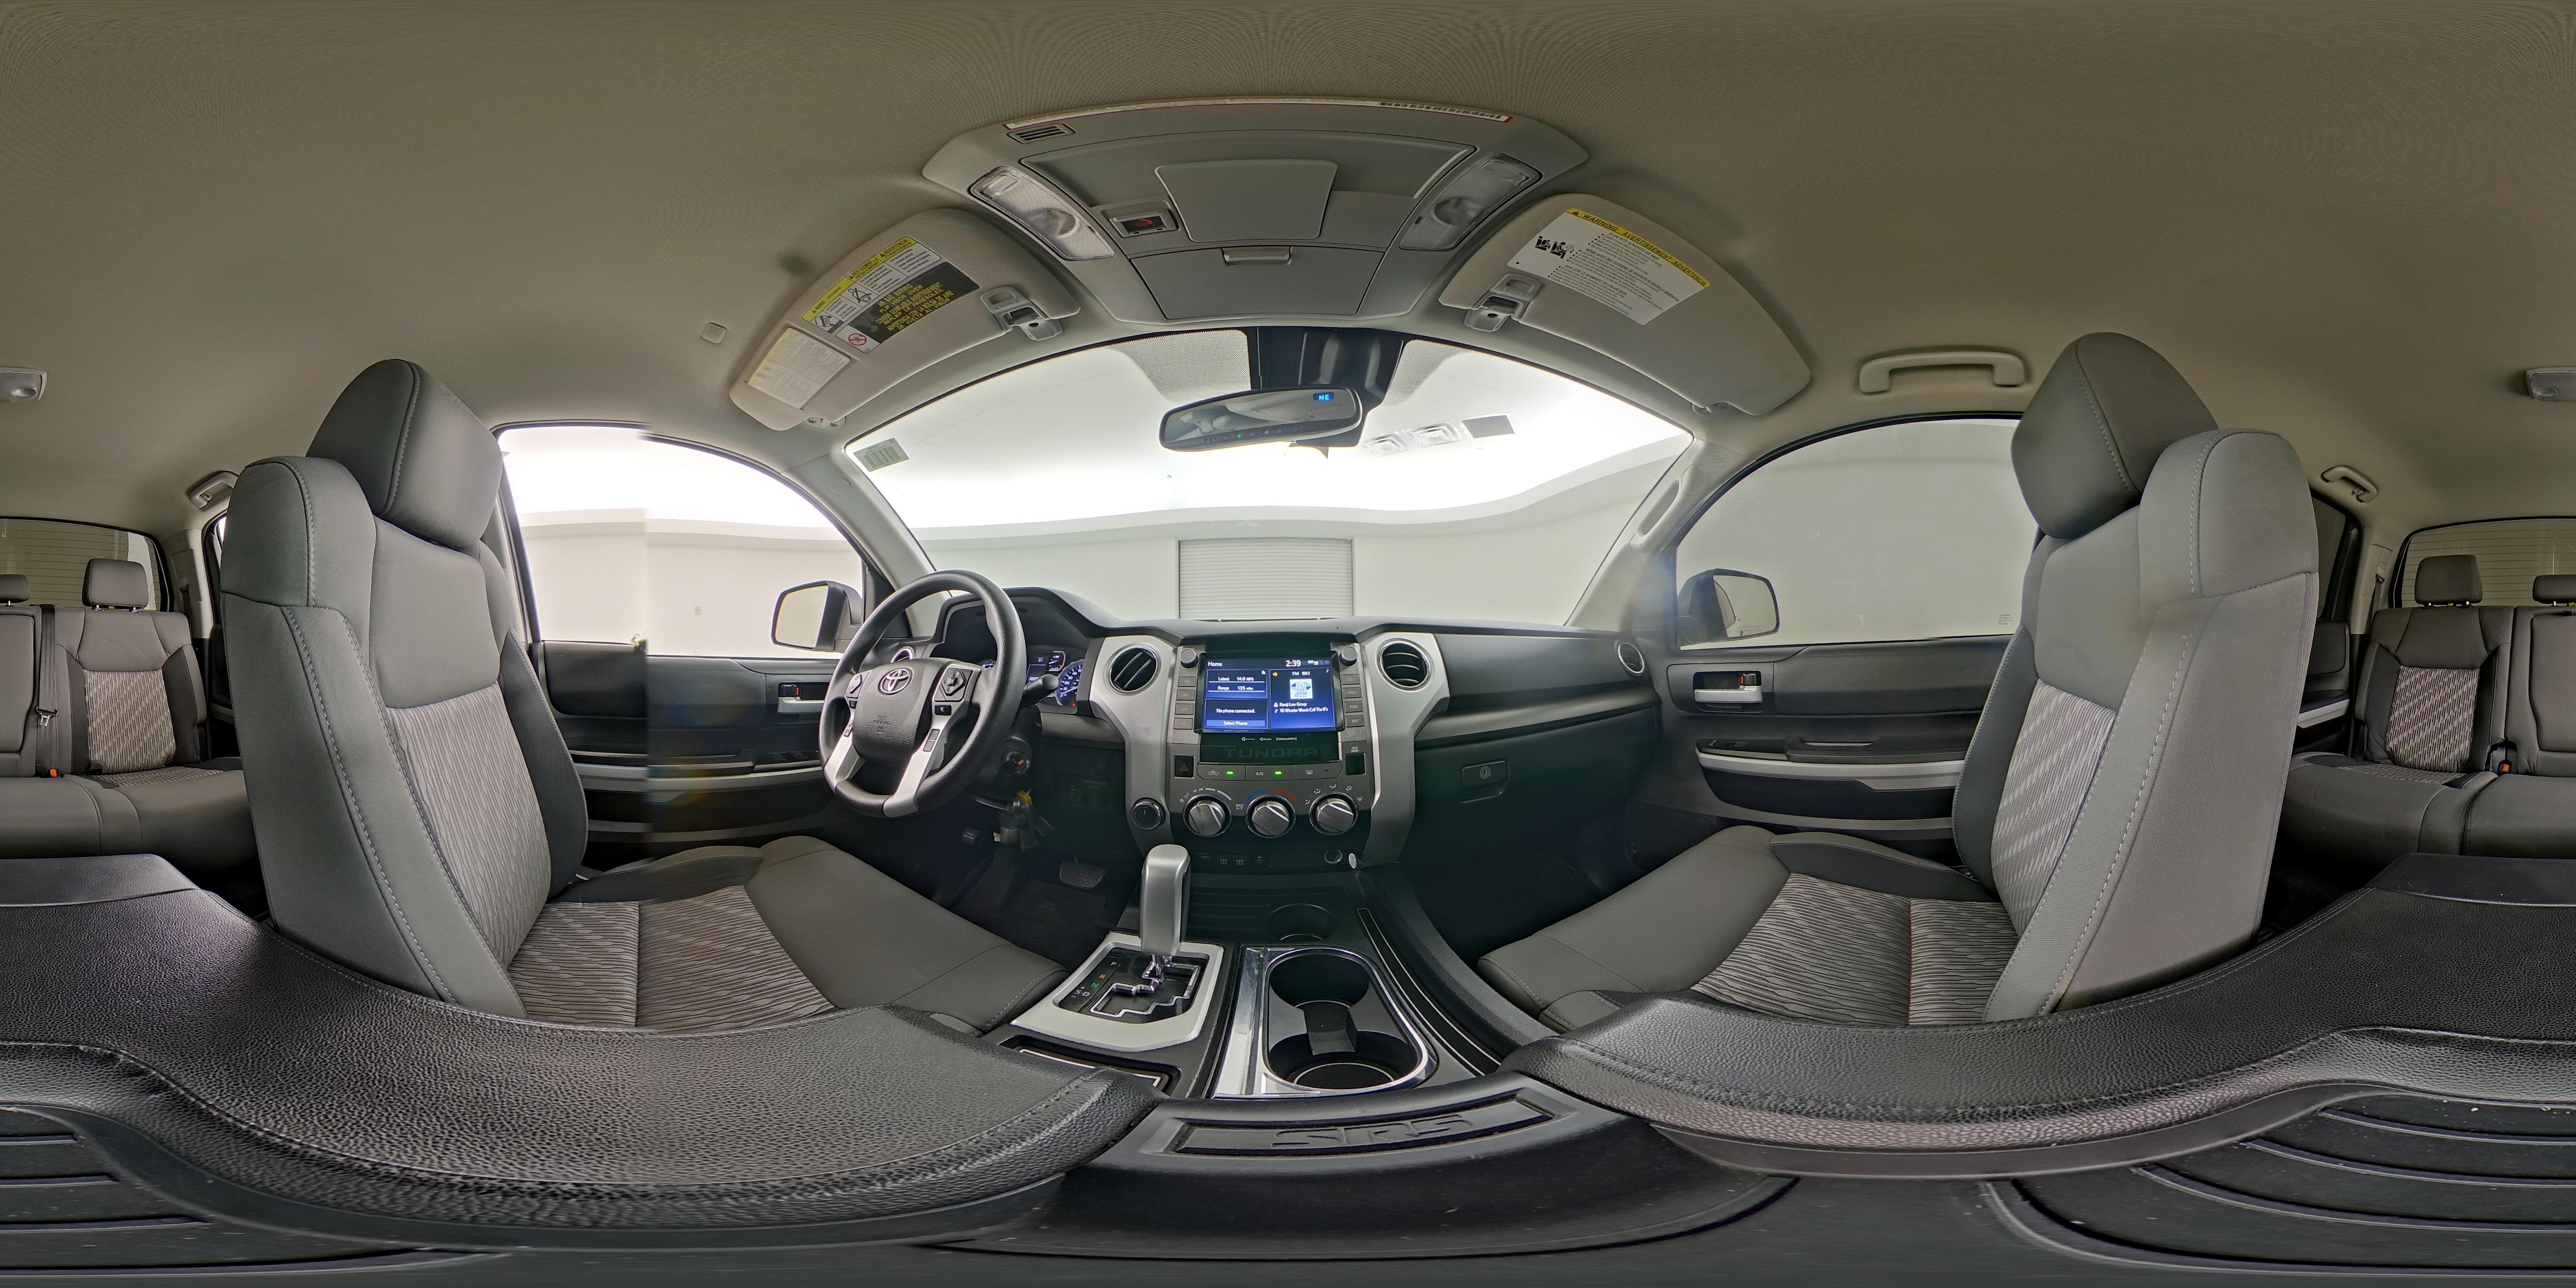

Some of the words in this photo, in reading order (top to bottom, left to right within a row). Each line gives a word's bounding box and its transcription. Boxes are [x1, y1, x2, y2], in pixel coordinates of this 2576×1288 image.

[884, 239, 908, 254] ADVERTENCIA
[1582, 214, 1619, 232] WARNING
[1621, 232, 1673, 261] AVERTISSEMENT
[1672, 261, 1707, 286] ADVERTENCIA
[1628, 242, 1646, 252] ADVANCED
[875, 310, 892, 324] COUSSIN
[889, 299, 913, 315] GONFLABLE
[910, 282, 943, 302] AVERTISSEMENT
[879, 305, 890, 313] FLIP
[890, 294, 907, 306] VISOR
[908, 285, 923, 295] OVER
[893, 283, 913, 296] WARNING
[883, 312, 903, 325] REPLIER
[912, 289, 944, 307] PARESOLEIL
[887, 314, 910, 331] ADVERTENCIA
[922, 299, 937, 309] BOLSA
[942, 290, 955, 298] AIRE
[906, 313, 924, 325] VUELTA
[934, 298, 951, 309] VISOR
[1223, 748, 1317, 758] TUNDRA
[1271, 1114, 1472, 1149] SR5
